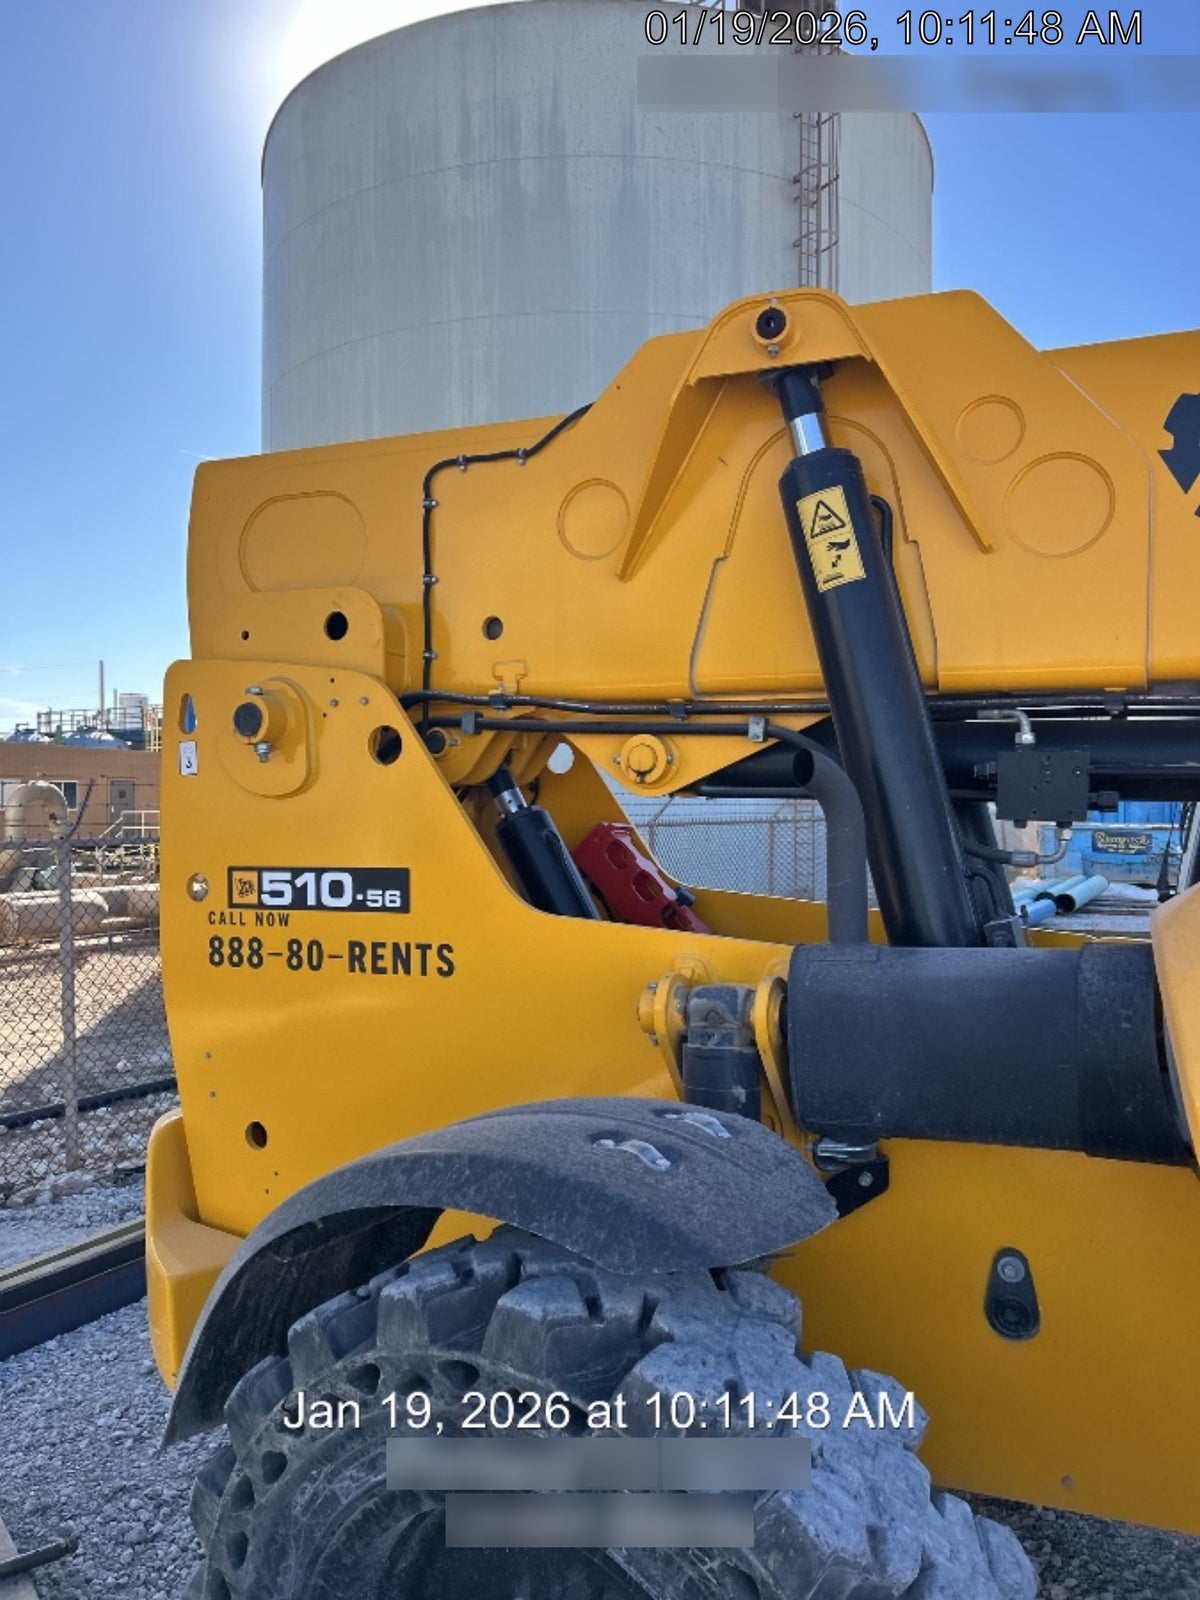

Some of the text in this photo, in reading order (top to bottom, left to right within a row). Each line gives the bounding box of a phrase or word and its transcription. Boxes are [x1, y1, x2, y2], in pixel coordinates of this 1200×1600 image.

[208, 911, 290, 927] CALL NOW
[208, 935, 455, 978] 888-80-RENTS
